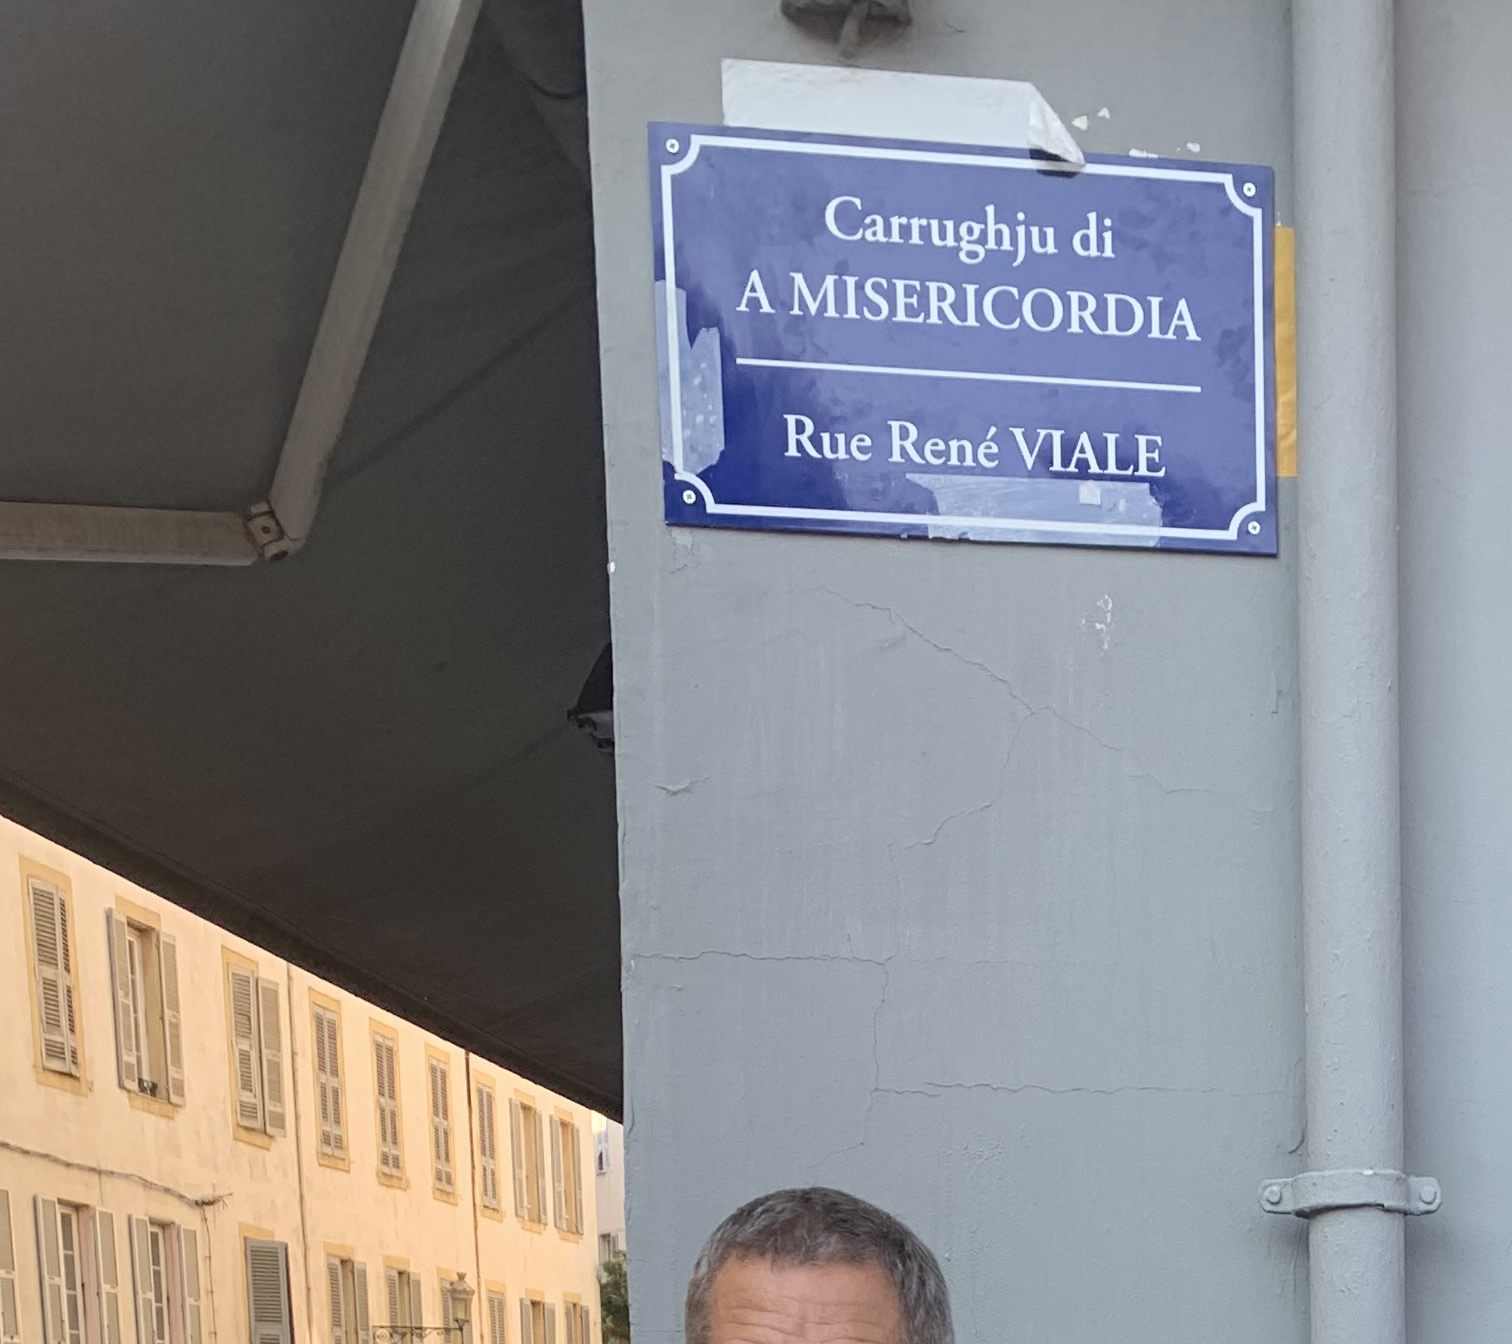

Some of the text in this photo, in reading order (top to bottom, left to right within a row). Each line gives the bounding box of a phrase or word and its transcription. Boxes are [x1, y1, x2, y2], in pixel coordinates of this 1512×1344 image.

[825, 195, 1116, 267] Carrughju di
[736, 269, 1203, 342] A MISERICORDIA
[783, 413, 1167, 478] Rue René VIALE
